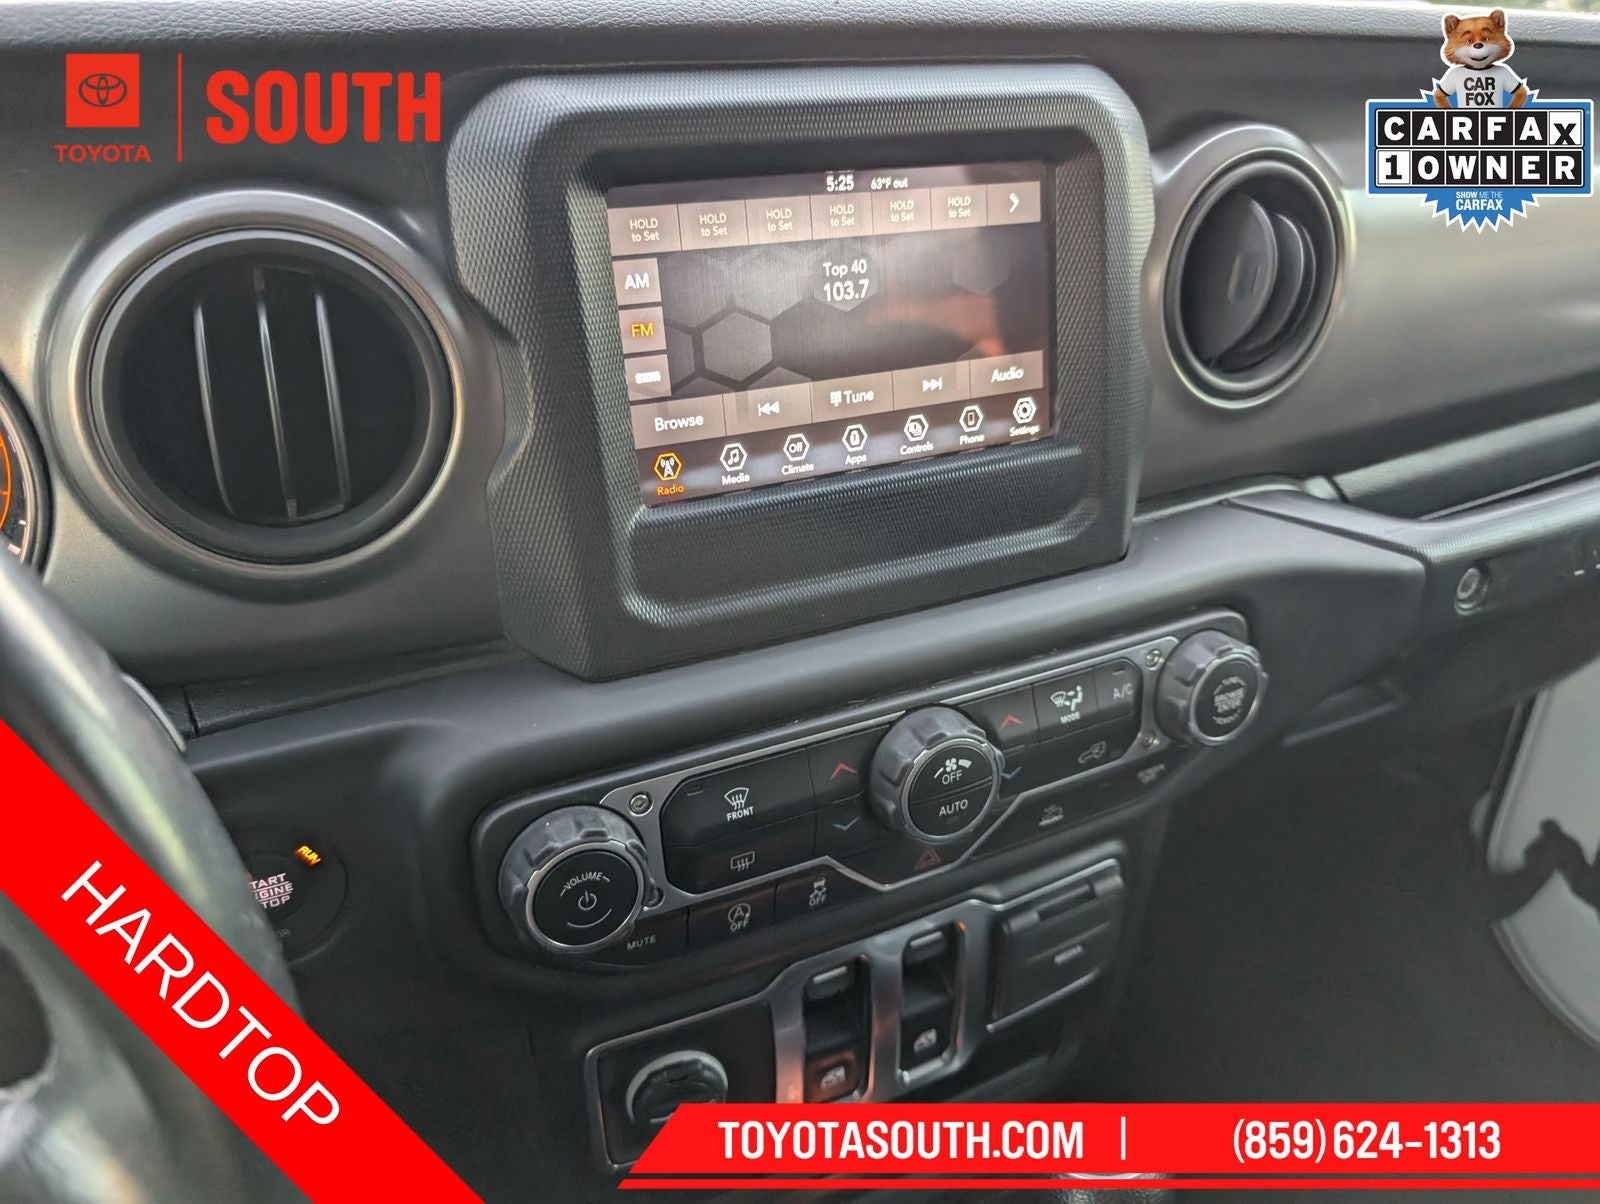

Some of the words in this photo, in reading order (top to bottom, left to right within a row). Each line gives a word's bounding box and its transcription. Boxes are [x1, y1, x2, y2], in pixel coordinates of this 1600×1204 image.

[826, 174, 855, 192] 5:25
[890, 200, 914, 212] HOLD
[948, 196, 971, 208] HOLD
[766, 209, 792, 221] HOLD
[829, 204, 855, 216] HOLD
[891, 213, 900, 223] to
[900, 211, 914, 222] Set
[949, 209, 958, 219] to
[958, 207, 971, 218] Set
[629, 218, 659, 230] HOLD
[699, 213, 727, 225] HOLD
[767, 221, 777, 232] to
[778, 220, 793, 231] Set
[830, 216, 840, 227] to
[841, 215, 855, 226] Set
[631, 230, 642, 243] to
[643, 229, 660, 241] Set
[701, 225, 711, 237] to
[712, 224, 728, 235] Set
[823, 263, 848, 278] Top
[850, 259, 867, 276] 40
[624, 273, 650, 290] AM
[823, 279, 870, 302] 103.7
[630, 322, 655, 338] FM
[991, 366, 1025, 385] Audio
[844, 388, 875, 405] Tune
[654, 415, 704, 432] Browse
[959, 434, 985, 446] Phone
[788, 441, 804, 455] Off
[900, 441, 934, 456] Controls
[845, 452, 867, 466] Apps
[781, 461, 815, 477] Climate
[721, 471, 750, 485] Media
[656, 482, 685, 497] Radio
[1112, 683, 1134, 700] A/C
[1060, 711, 1081, 724] MODE
[941, 769, 964, 785] OFF
[726, 806, 755, 822] FRONT
[938, 799, 970, 817] AUTO
[296, 845, 322, 866] RUN
[249, 872, 287, 889] TART
[564, 871, 603, 891] VOLUME
[808, 894, 827, 907] OFF
[730, 920, 749, 932] OFF
[626, 935, 657, 950] MUTE
